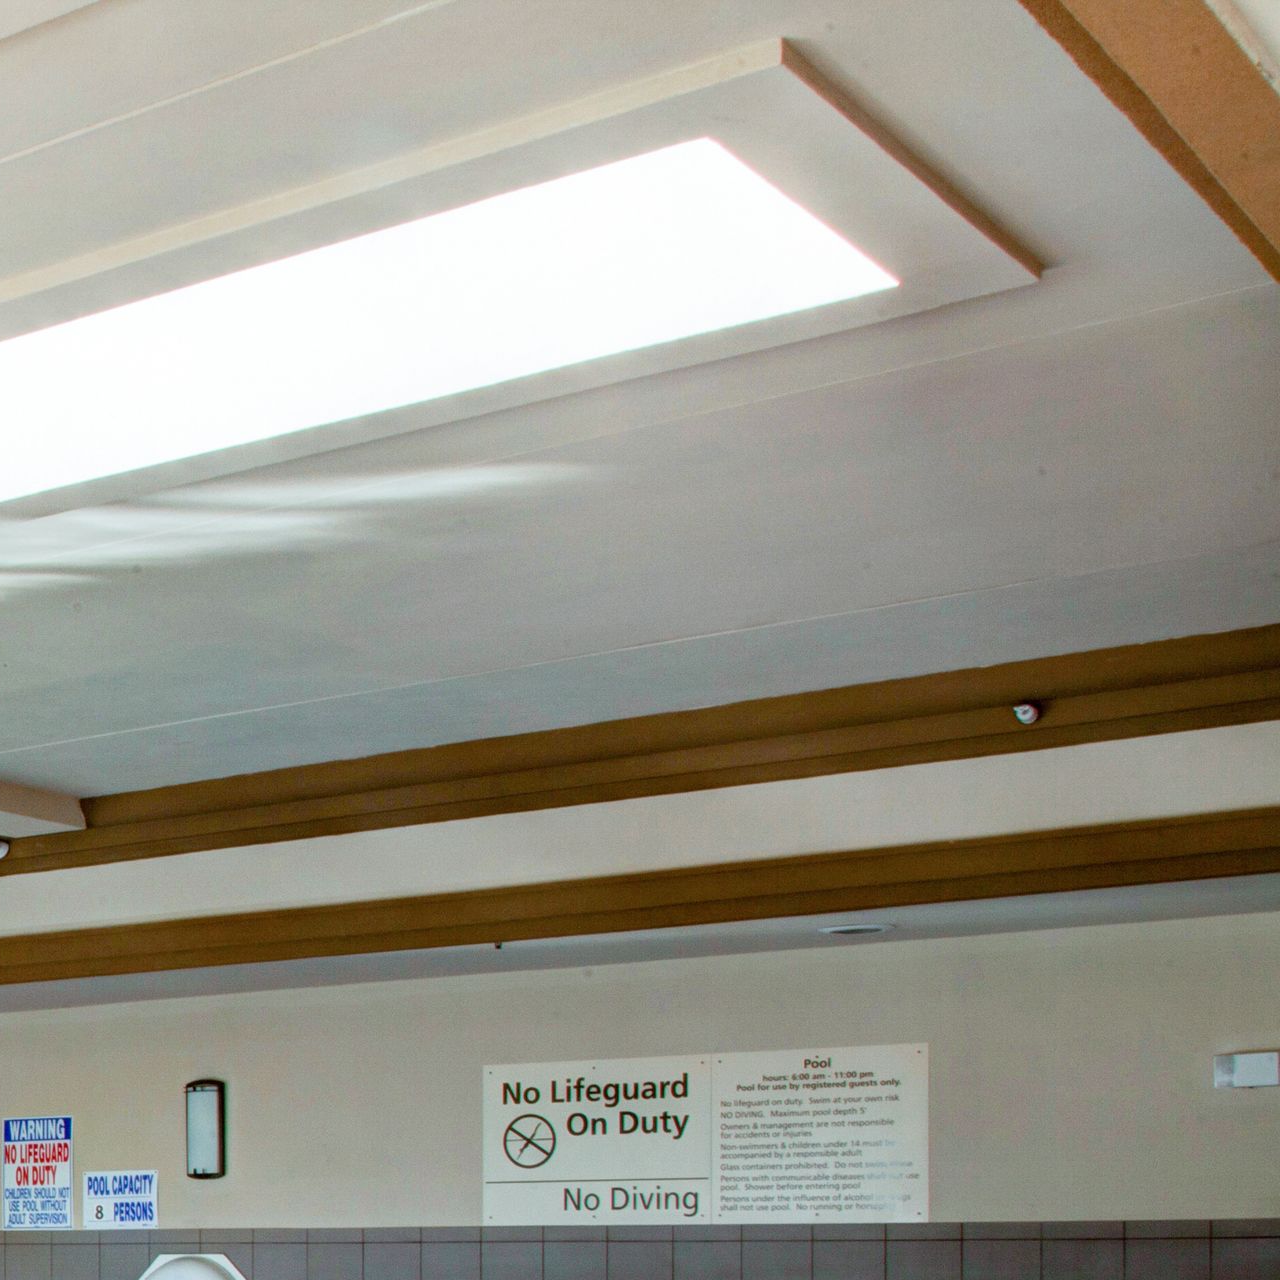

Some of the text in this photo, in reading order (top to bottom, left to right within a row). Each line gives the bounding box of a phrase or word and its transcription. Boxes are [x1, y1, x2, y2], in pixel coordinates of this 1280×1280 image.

[804, 1058, 832, 1069] Pool
[835, 1071, 856, 1079] 11:00
[860, 1071, 874, 1079] pm
[502, 1072, 688, 1107] No Lifeguard
[736, 1084, 754, 1092] Pool
[757, 1083, 769, 1091] for
[789, 1083, 799, 1091] by
[802, 1081, 846, 1090] registered
[849, 1080, 878, 1088] guests
[720, 1100, 731, 1108] No
[733, 1098, 770, 1108] lifeguard
[885, 1094, 900, 1102] risk
[720, 1111, 733, 1119] NO
[770, 1109, 810, 1117] Maximum
[812, 1109, 831, 1117] pool
[832, 1108, 857, 1116] depth
[10, 1119, 65, 1141] WARNING
[567, 1111, 689, 1140] On Duty
[720, 1123, 750, 1131] Owners
[760, 1121, 813, 1131] management
[848, 1119, 895, 1128] responsible
[783, 1130, 813, 1139] injuries
[720, 1143, 778, 1151] Non-swimmers
[789, 1141, 821, 1149] children
[5, 1143, 69, 1164] NO LIFEGUARD
[720, 1151, 772, 1160] accompanied
[774, 1151, 784, 1159] by
[793, 1150, 838, 1158] responsible
[841, 1149, 863, 1157] adult
[720, 1163, 740, 1171] Glass
[16, 1166, 57, 1186] ON DUTY
[772, 1173, 830, 1181] communicable
[88, 1174, 154, 1196] POOL CAPACITY
[805, 1182, 840, 1191] entering
[842, 1182, 861, 1190] pool
[5, 1187, 69, 1199] CHILDREN SHOULD NOT
[720, 1194, 750, 1202] Persons
[9, 1200, 67, 1212] USE POOL WITHOUT
[563, 1186, 699, 1217] No Diving
[96, 1202, 153, 1222] 8 PERSONS
[9, 1213, 67, 1224] ADULT SUPERVISION
